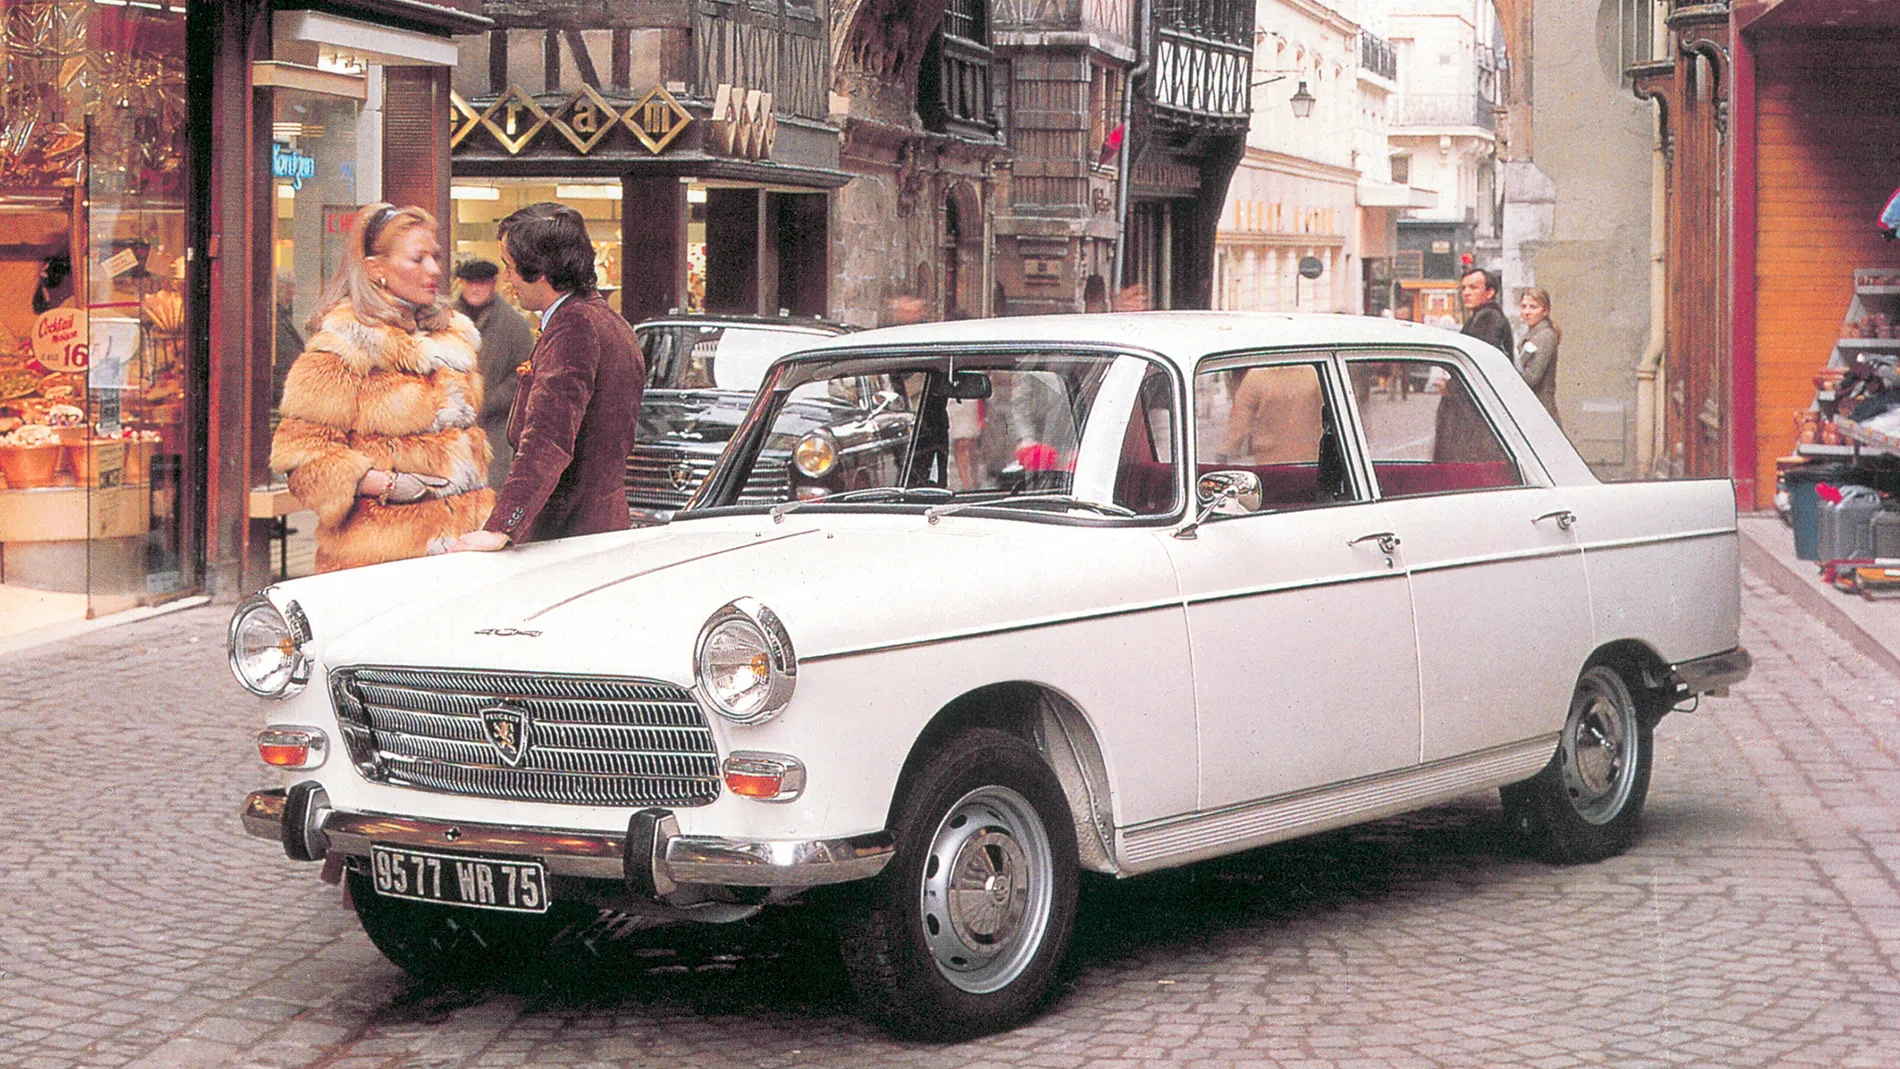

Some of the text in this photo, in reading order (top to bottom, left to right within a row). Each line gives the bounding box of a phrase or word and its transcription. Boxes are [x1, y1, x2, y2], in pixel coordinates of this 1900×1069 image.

[485, 713, 520, 722] PEUGEOT
[456, 862, 496, 904] WR
[501, 866, 539, 907] 75
